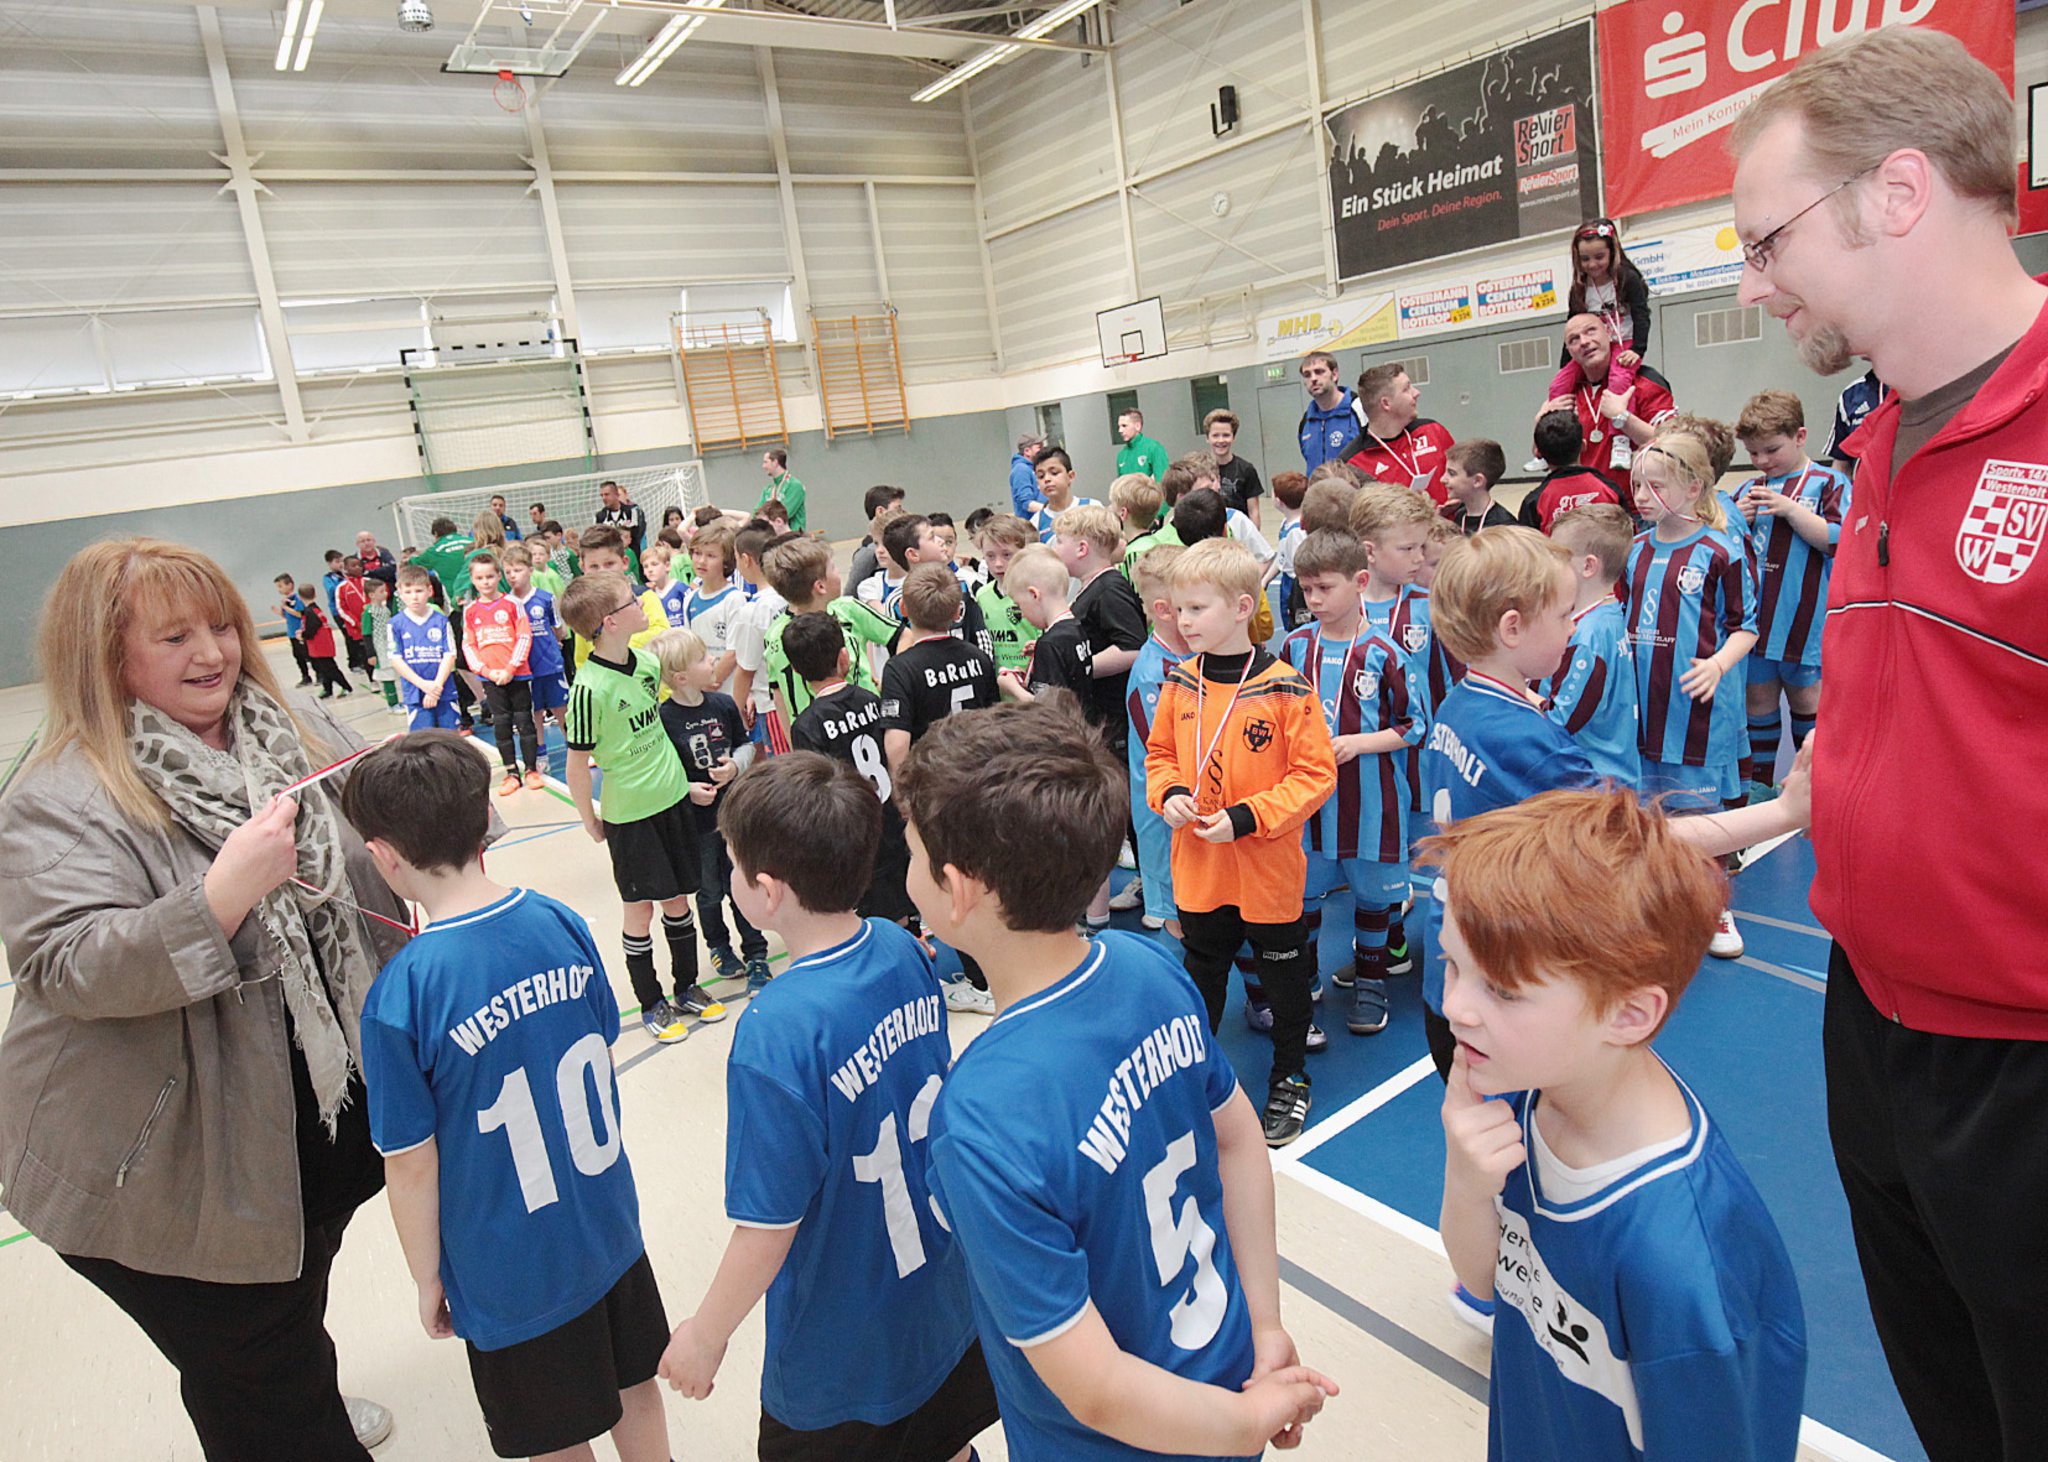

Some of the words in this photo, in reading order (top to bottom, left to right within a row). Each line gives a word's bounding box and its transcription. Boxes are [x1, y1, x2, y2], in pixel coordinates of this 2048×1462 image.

[1672, 115, 1704, 140] Mein
[1707, 96, 1747, 124] Konto
[1519, 134, 1564, 166] Sport
[1341, 196, 1368, 218] Ein
[1372, 177, 1424, 210] Stück
[1427, 154, 1503, 193] Heimat
[1377, 213, 1400, 231] Dein
[1401, 208, 1430, 226] Sport.
[1431, 200, 1462, 217] Deine
[1463, 189, 1503, 210] Region.
[1633, 253, 1664, 265] GmbH
[1477, 270, 1552, 294] OSTERMANN
[1485, 284, 1543, 304] CENTRUM
[1401, 284, 1468, 308] OSTERMANN
[1479, 298, 1533, 317] BOTTROP
[1278, 312, 1322, 337] MHB
[1402, 312, 1451, 330] BOTTROP
[1408, 300, 1460, 327] CENTRUM
[1412, 435, 1428, 450] 27
[1988, 463, 2025, 479] Sportv.
[1984, 479, 2047, 498] Westerholt
[2006, 501, 2046, 539] SV
[1962, 536, 1994, 569] W
[1322, 656, 1344, 665] JAKO
[1180, 712, 1196, 721] JAKO
[851, 733, 893, 805] 8
[829, 994, 940, 1104] WESTERHOLT
[476, 1032, 621, 1215] 10
[1141, 1128, 1229, 1351] 5
